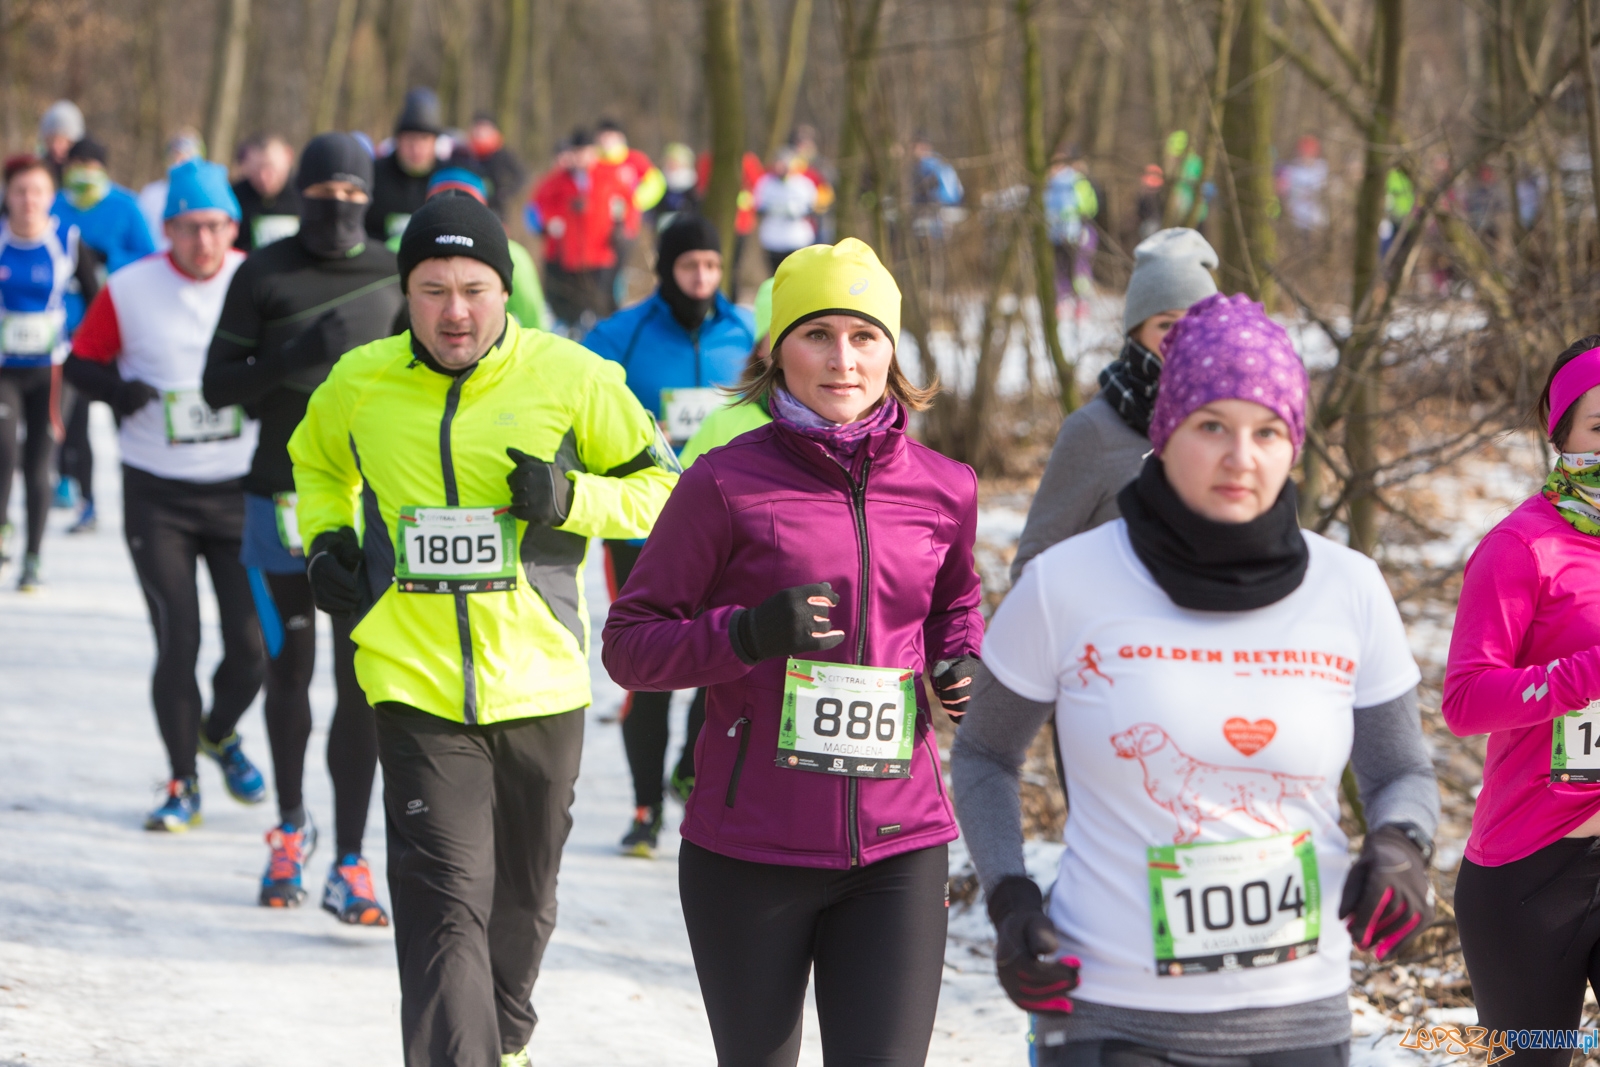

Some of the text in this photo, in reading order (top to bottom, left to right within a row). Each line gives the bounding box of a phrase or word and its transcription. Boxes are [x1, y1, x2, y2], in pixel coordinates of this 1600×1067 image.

[437, 234, 474, 248] KIPSTO
[413, 534, 496, 564] 1805
[1118, 645, 1223, 663] GOLDEN
[1261, 668, 1304, 677] TEAM
[813, 697, 897, 742] 886
[822, 742, 883, 756] MAGDALENA
[1175, 874, 1306, 934] 1004
